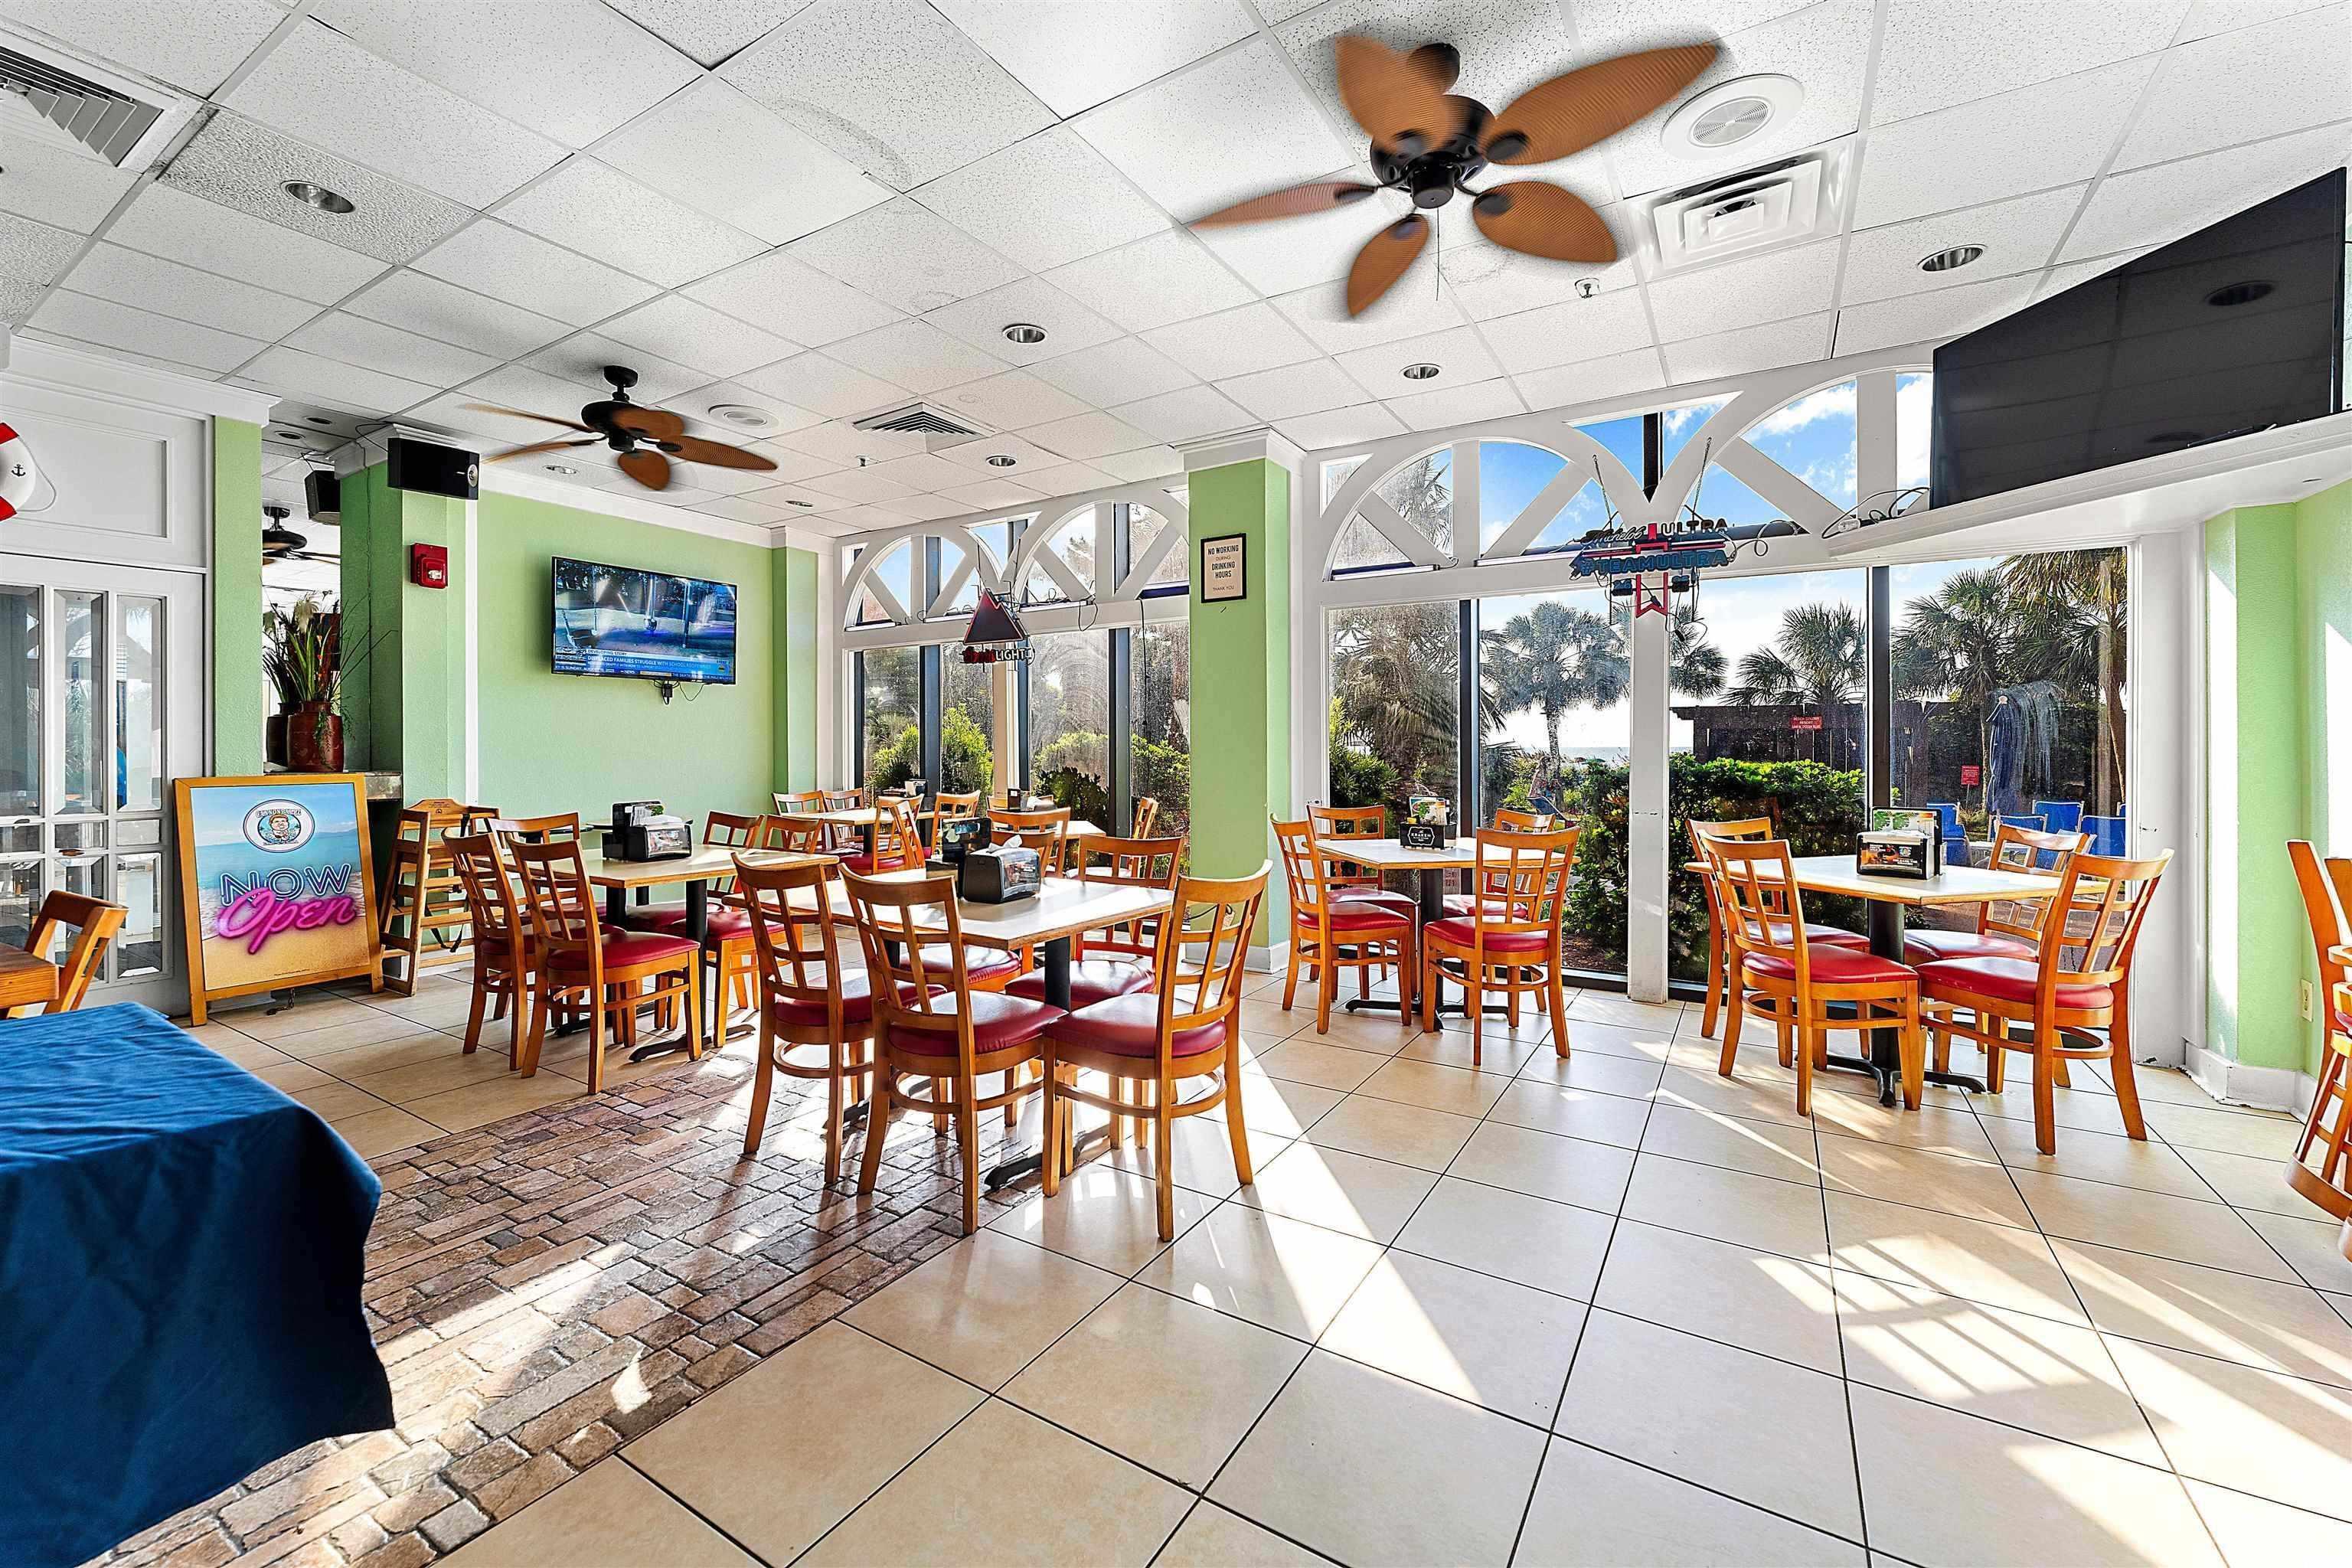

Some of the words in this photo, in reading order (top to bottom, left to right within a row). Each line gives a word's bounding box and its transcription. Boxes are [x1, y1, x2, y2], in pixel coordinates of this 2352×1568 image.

[1661, 518, 1728, 536] ULTRA
[1216, 545, 1239, 554] WORKING
[1211, 561, 1235, 570] DRINKING
[1579, 550, 1728, 576] #TEAMULTRA
[1215, 570, 1232, 579] HOURS
[995, 648, 1025, 661] LIGHT
[220, 863, 351, 906] NOW
[217, 887, 357, 955] Open
